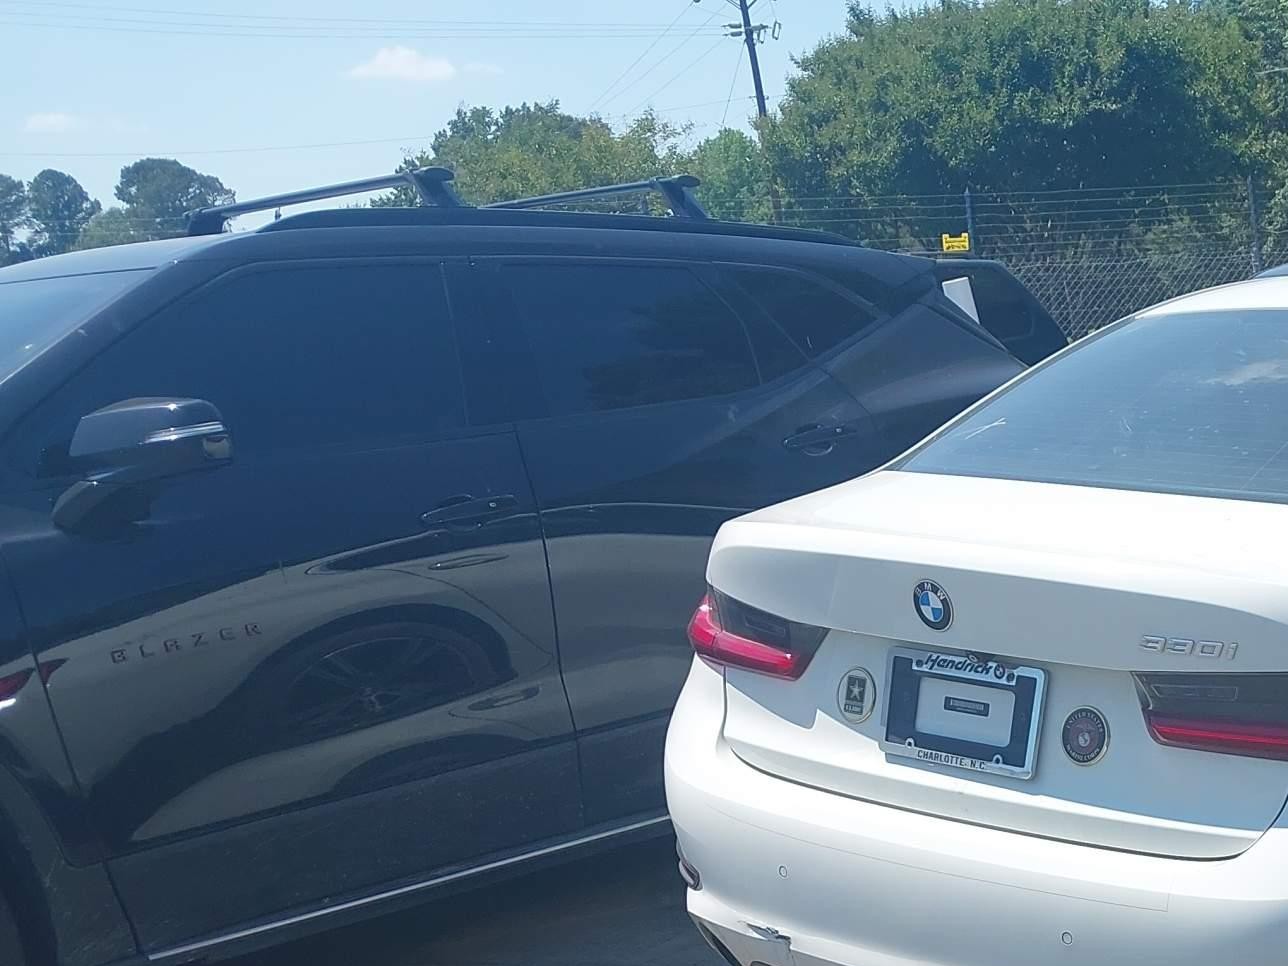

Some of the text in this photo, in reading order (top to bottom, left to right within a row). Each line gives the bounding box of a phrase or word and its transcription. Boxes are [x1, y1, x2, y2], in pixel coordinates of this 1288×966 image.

[914, 582, 946, 600] BMW
[110, 623, 263, 664] BLAZER
[1140, 634, 1239, 661] 330i
[924, 653, 993, 676] Hendrick
